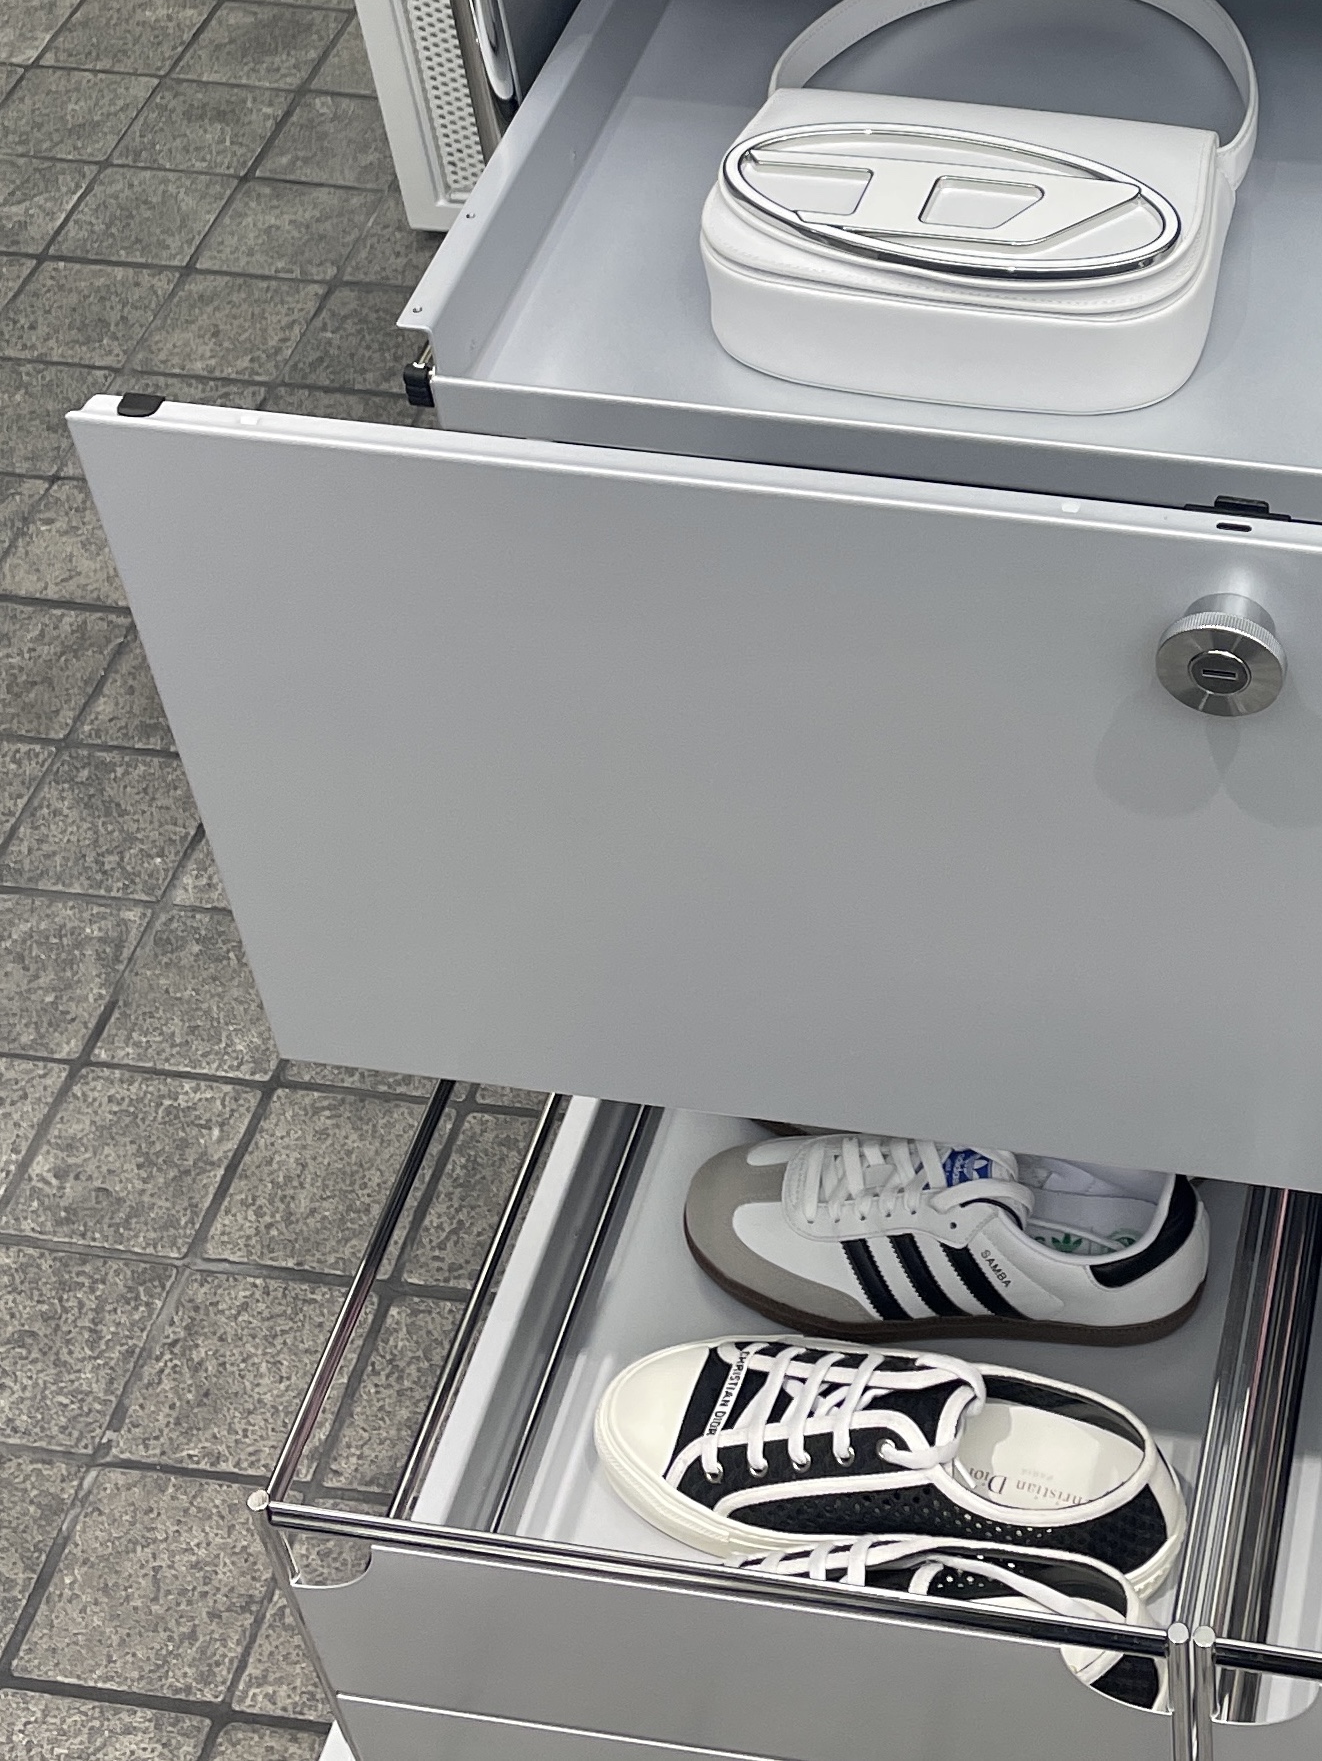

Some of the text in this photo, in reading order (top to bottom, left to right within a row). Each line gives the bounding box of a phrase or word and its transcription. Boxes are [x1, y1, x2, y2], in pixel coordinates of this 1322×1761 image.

[980, 1249, 1012, 1289] SAMBA
[706, 1350, 751, 1436] CHRISTIAN DIOR
